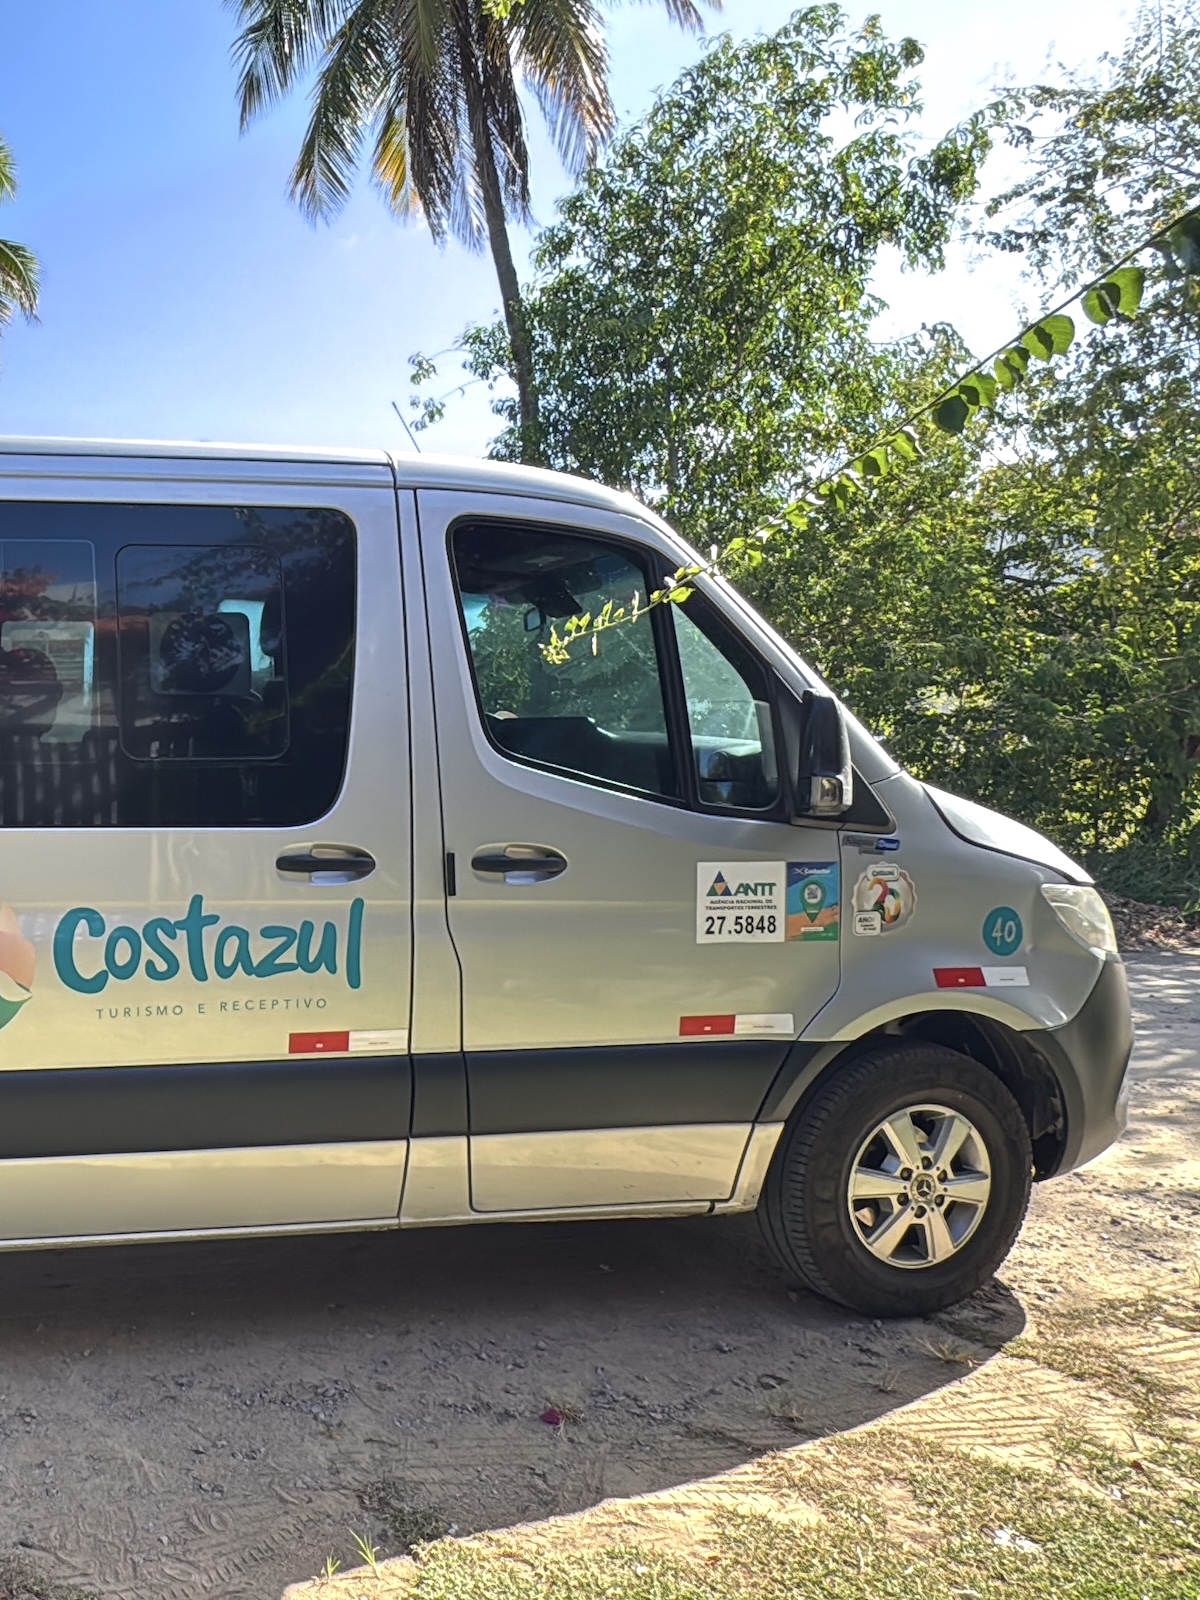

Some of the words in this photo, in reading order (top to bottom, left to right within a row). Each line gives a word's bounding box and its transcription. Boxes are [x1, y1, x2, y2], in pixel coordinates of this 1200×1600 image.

[732, 882, 777, 897] ANTT
[705, 915, 777, 935] 27.5848
[991, 916, 1016, 947] 40
[52, 893, 365, 995] Costazul
[96, 1004, 184, 1019] TURISMO
[197, 1003, 206, 1015] E
[220, 998, 328, 1012] RECEPTIVO
